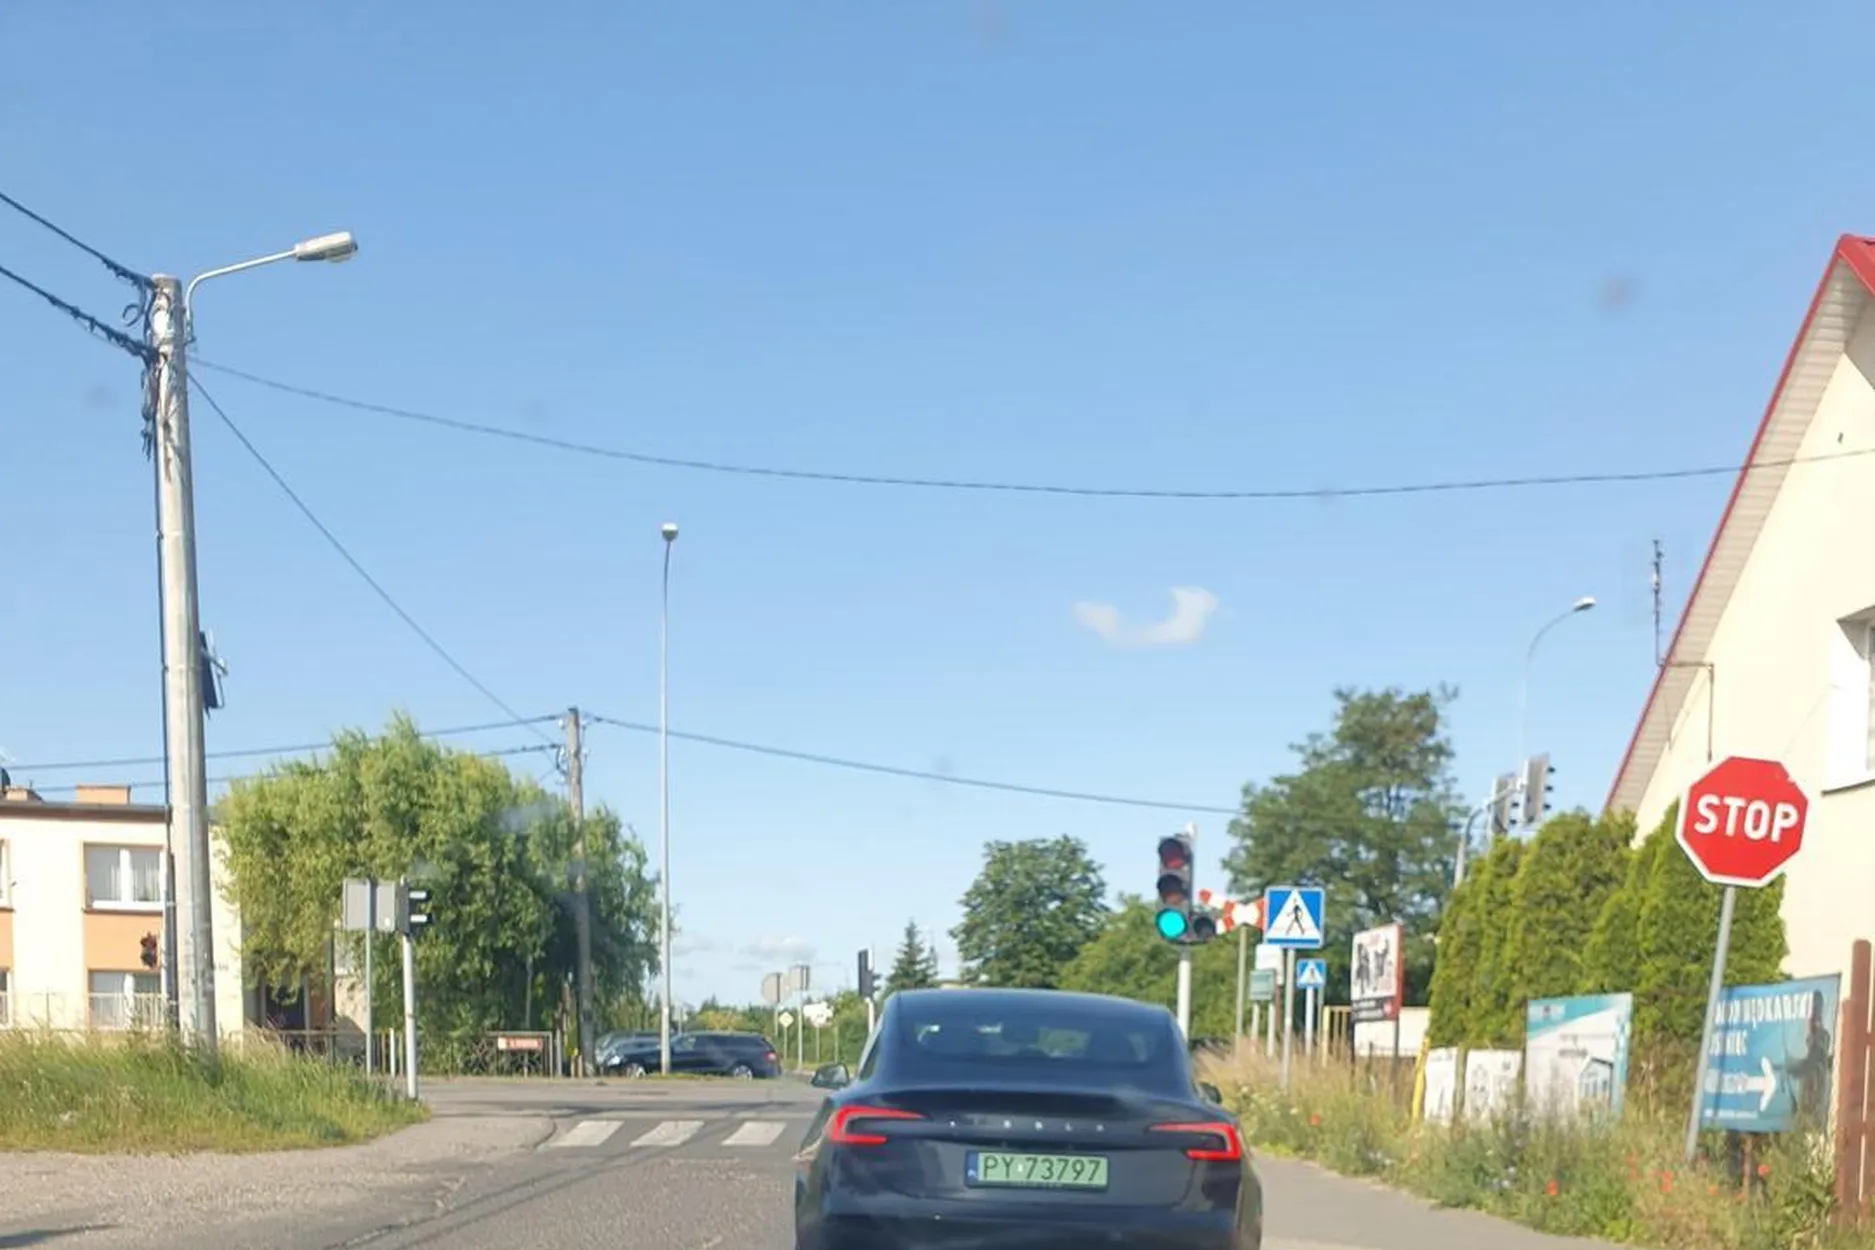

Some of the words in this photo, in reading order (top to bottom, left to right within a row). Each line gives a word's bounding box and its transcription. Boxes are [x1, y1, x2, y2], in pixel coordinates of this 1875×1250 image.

[1694, 793, 1799, 843] STOP
[984, 1155, 1013, 1179] PY
[1025, 1156, 1101, 1181] 73797
